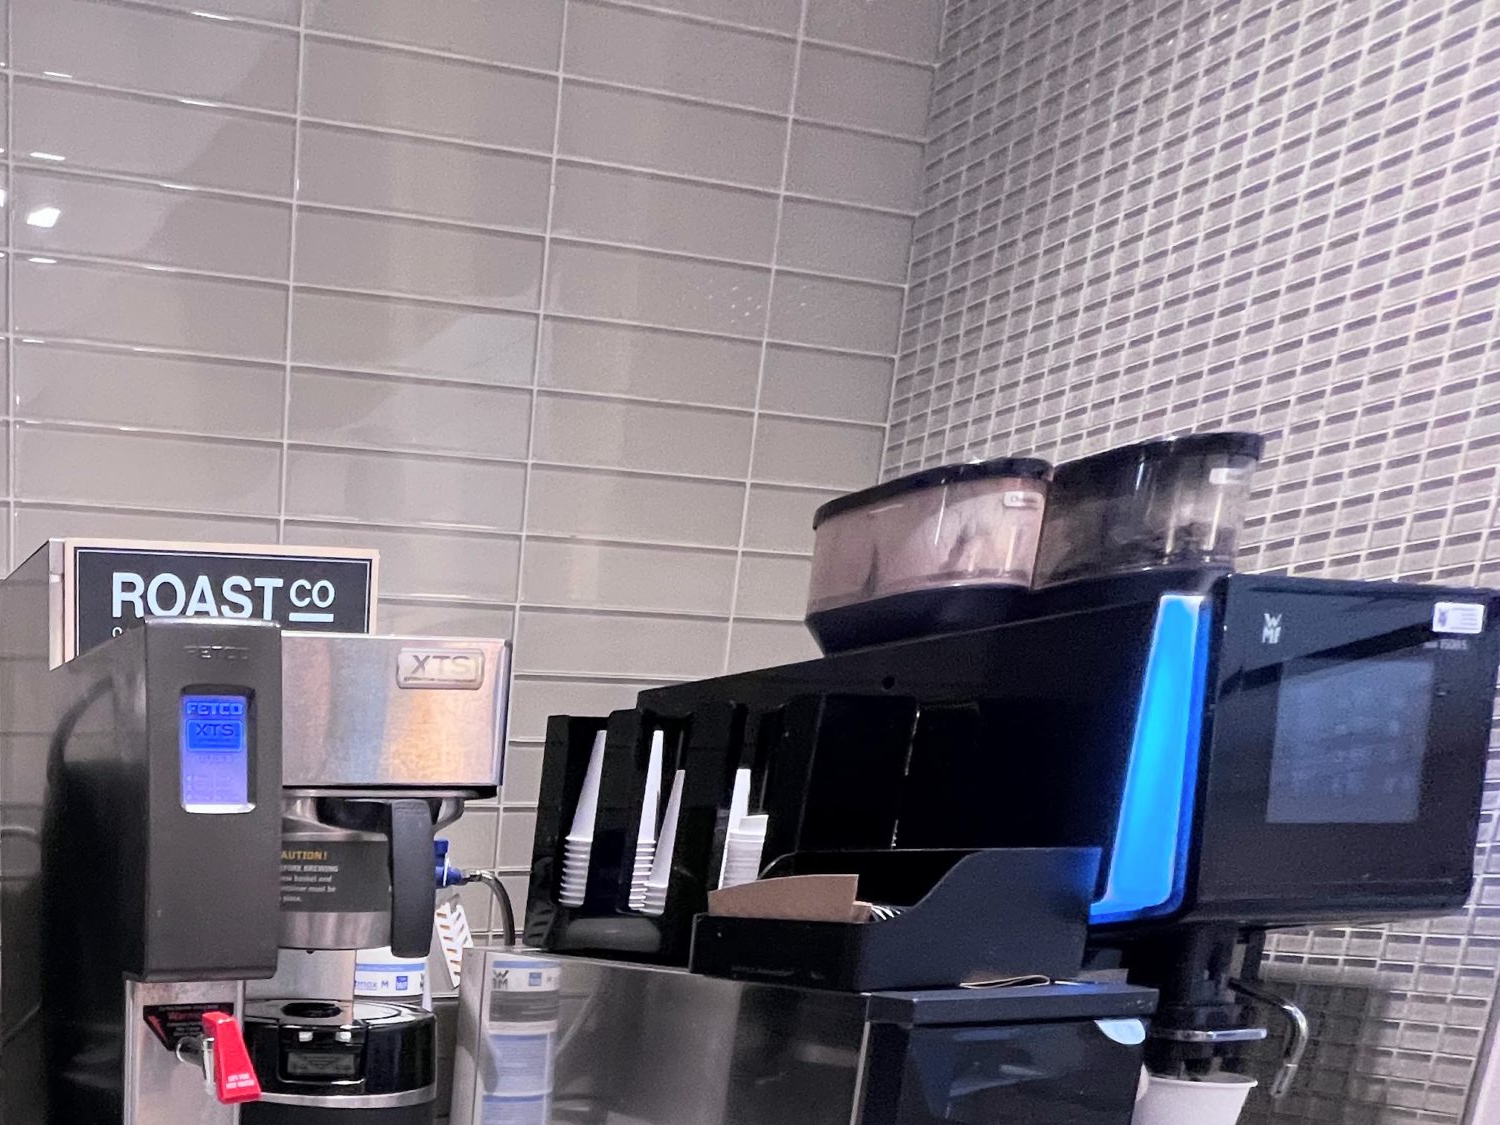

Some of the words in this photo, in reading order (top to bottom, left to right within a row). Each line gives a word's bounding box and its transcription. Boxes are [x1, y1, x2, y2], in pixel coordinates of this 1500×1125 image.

[112, 572, 284, 620] ROAST
[289, 579, 335, 608] CO
[411, 655, 471, 676] XTS
[186, 702, 243, 715] FETCO
[196, 723, 234, 736] XTS
[280, 850, 328, 860] AUTION!
